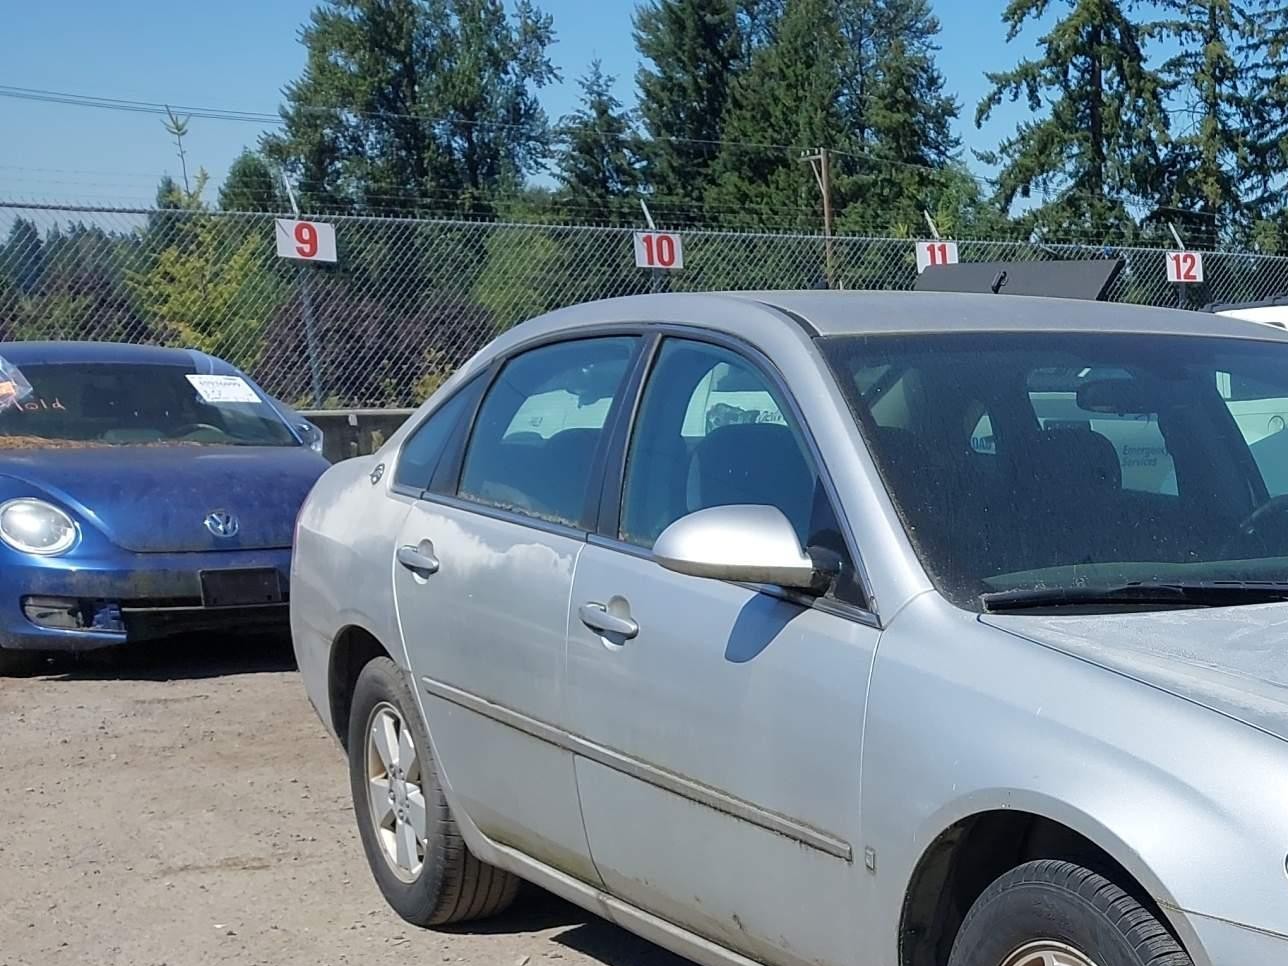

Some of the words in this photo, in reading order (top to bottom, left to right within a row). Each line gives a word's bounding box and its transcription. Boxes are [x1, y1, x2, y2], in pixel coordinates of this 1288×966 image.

[294, 221, 319, 258] 9
[642, 234, 675, 267] 10
[926, 243, 948, 266] 11
[1173, 253, 1198, 281] 12
